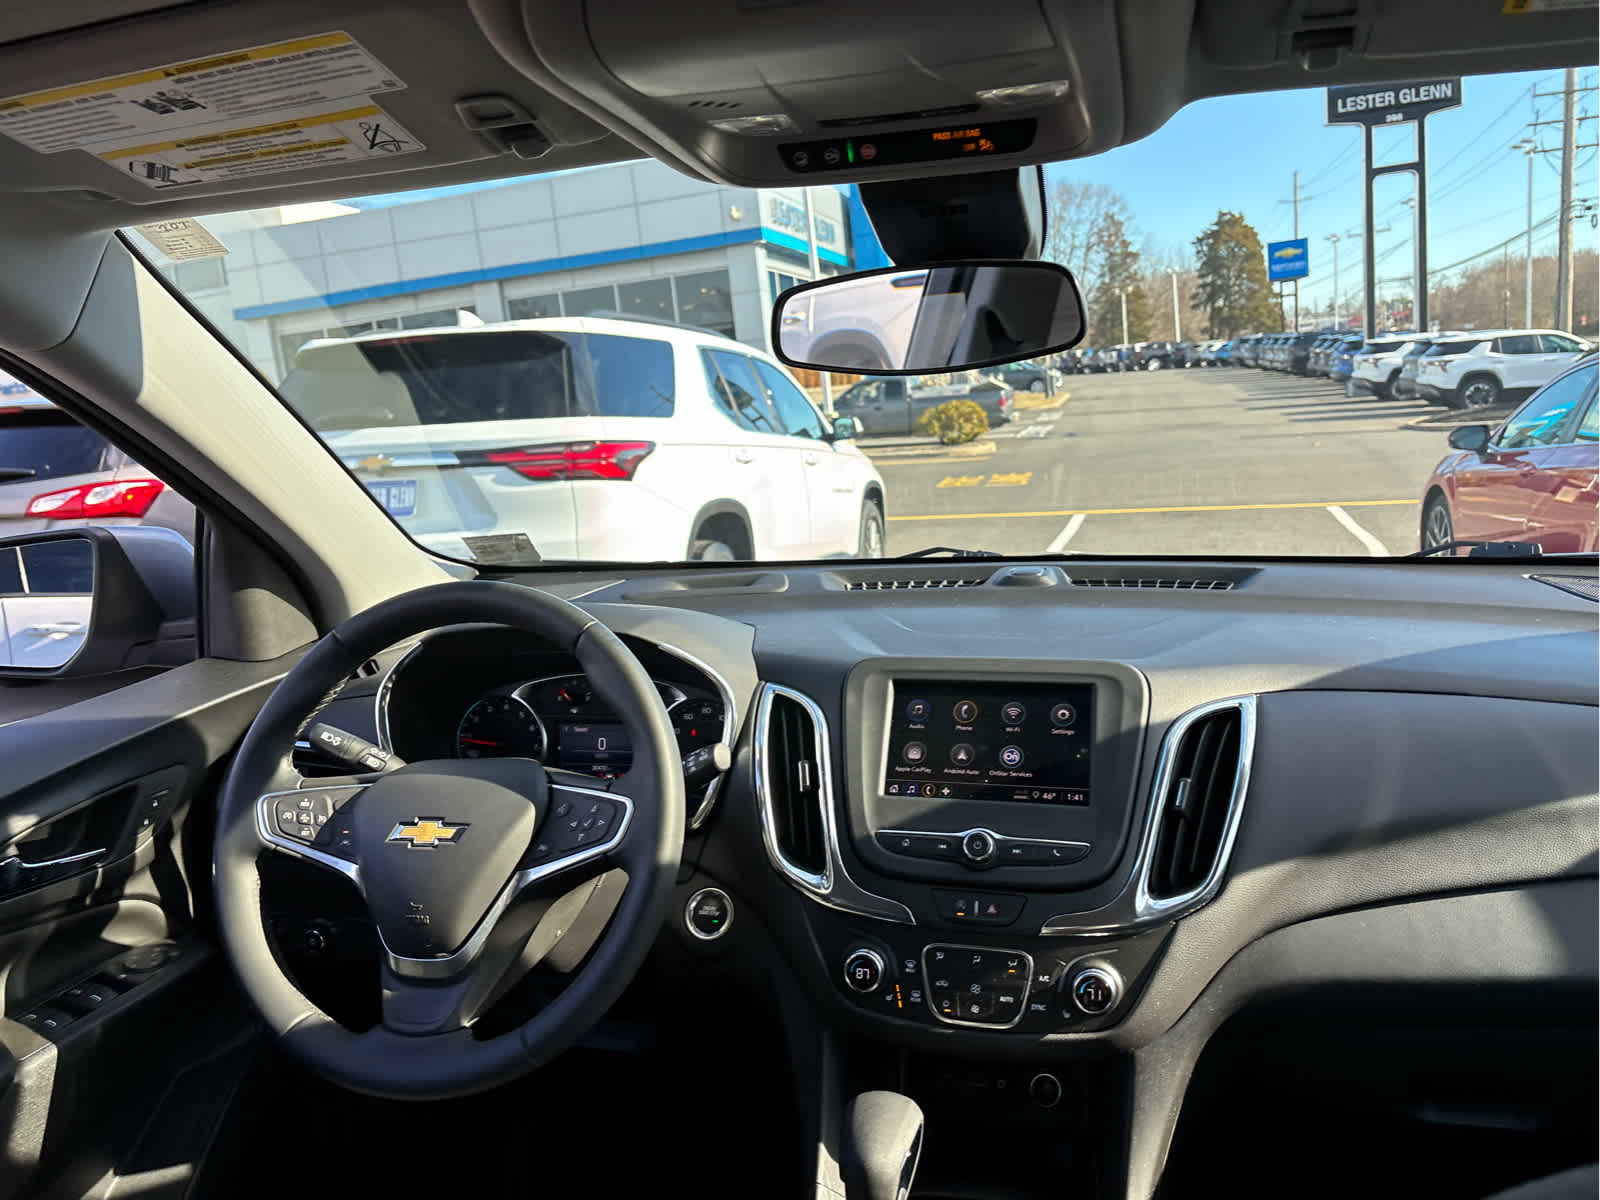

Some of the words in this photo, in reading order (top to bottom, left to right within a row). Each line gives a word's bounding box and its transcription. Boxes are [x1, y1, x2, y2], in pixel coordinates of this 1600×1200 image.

[1337, 90, 1396, 113] LESTER
[1399, 82, 1453, 104] GLENN
[1051, 728, 1075, 736] Settings
[598, 737, 606, 750] 0
[1009, 770, 1033, 778] Services
[1067, 793, 1084, 801] 1:41
[1086, 988, 1101, 1001] 71
